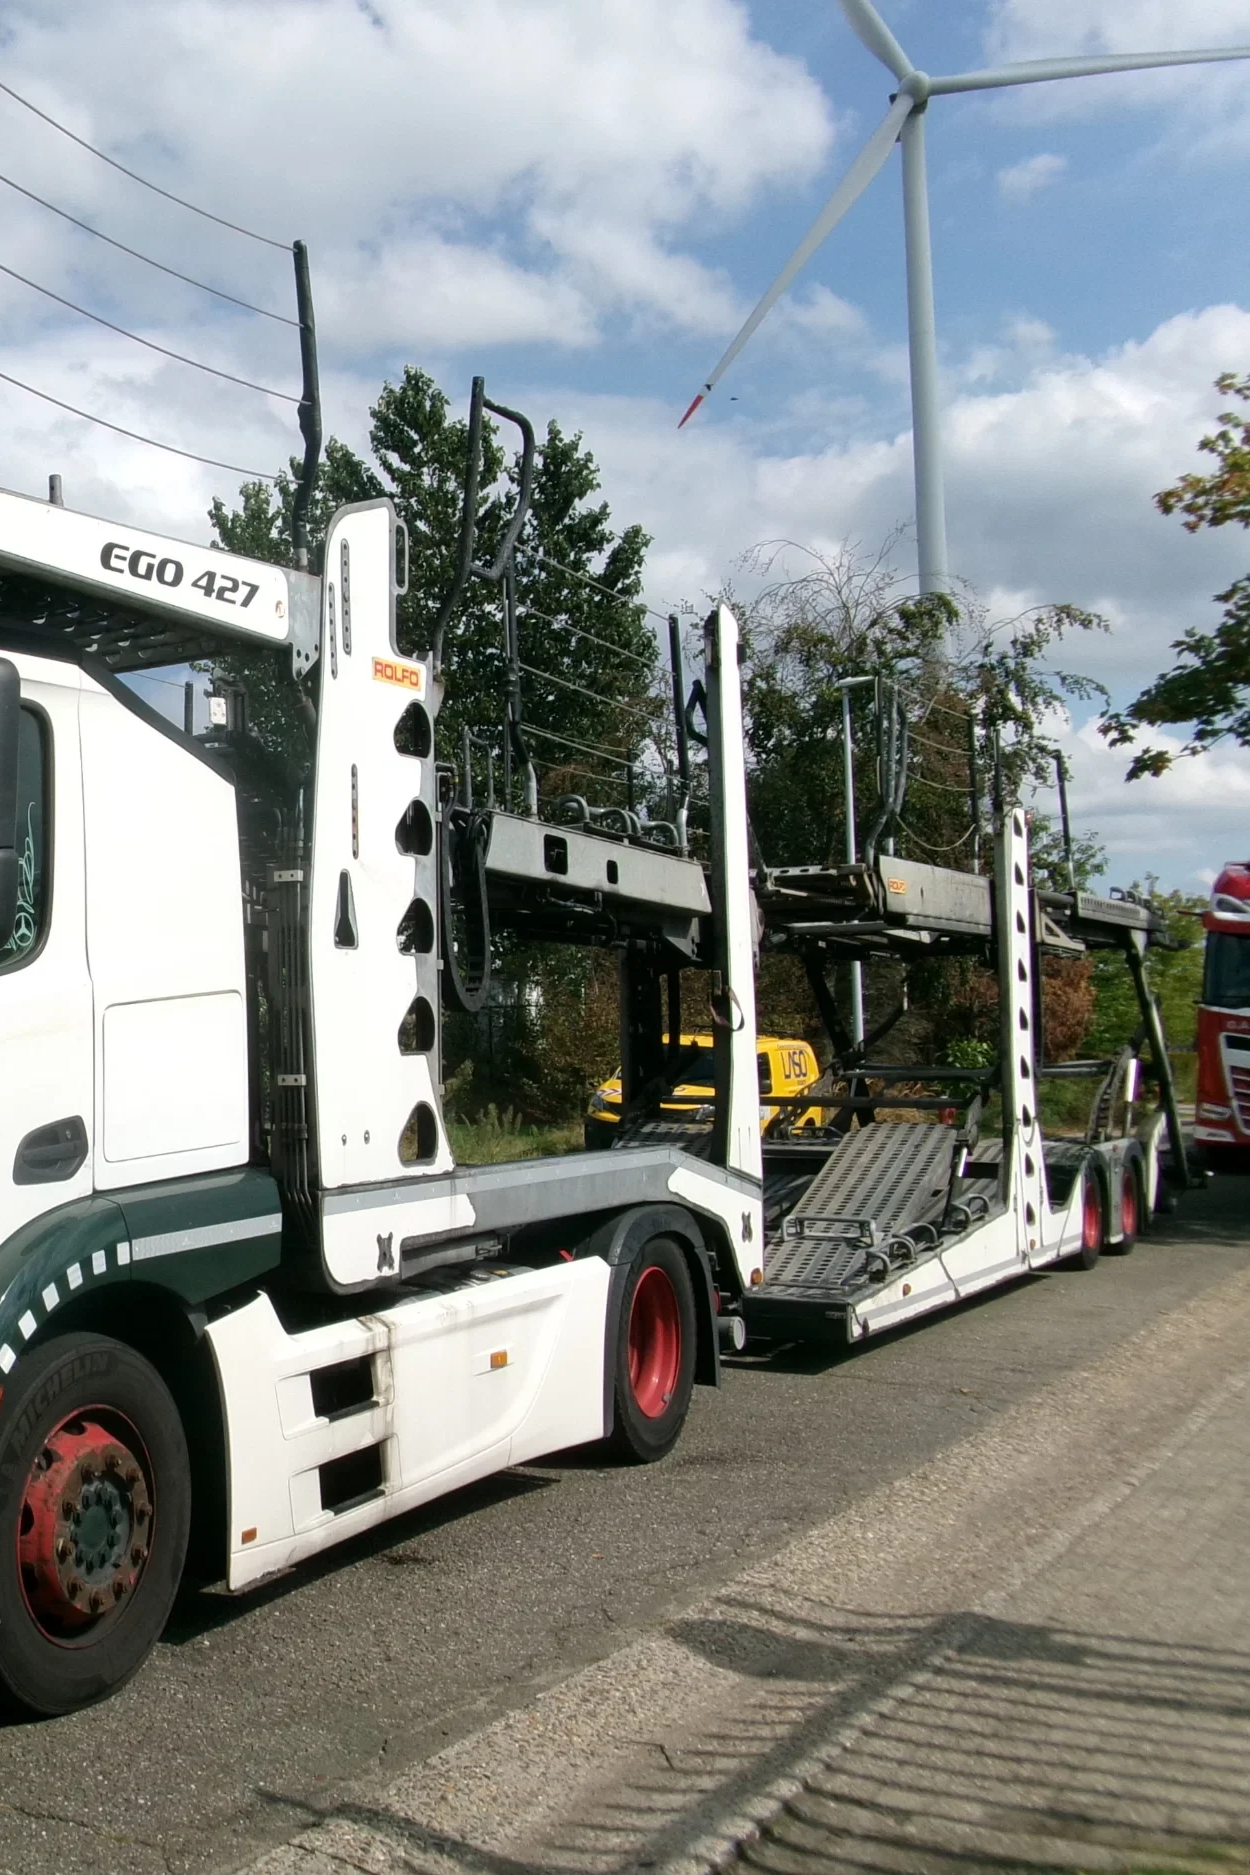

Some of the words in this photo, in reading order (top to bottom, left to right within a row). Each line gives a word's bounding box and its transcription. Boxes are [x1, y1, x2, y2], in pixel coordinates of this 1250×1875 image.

[100, 541, 184, 588] EGO
[191, 570, 260, 608] 427
[374, 660, 419, 687] ROLFO
[9, 1351, 110, 1453] MICHELIN
